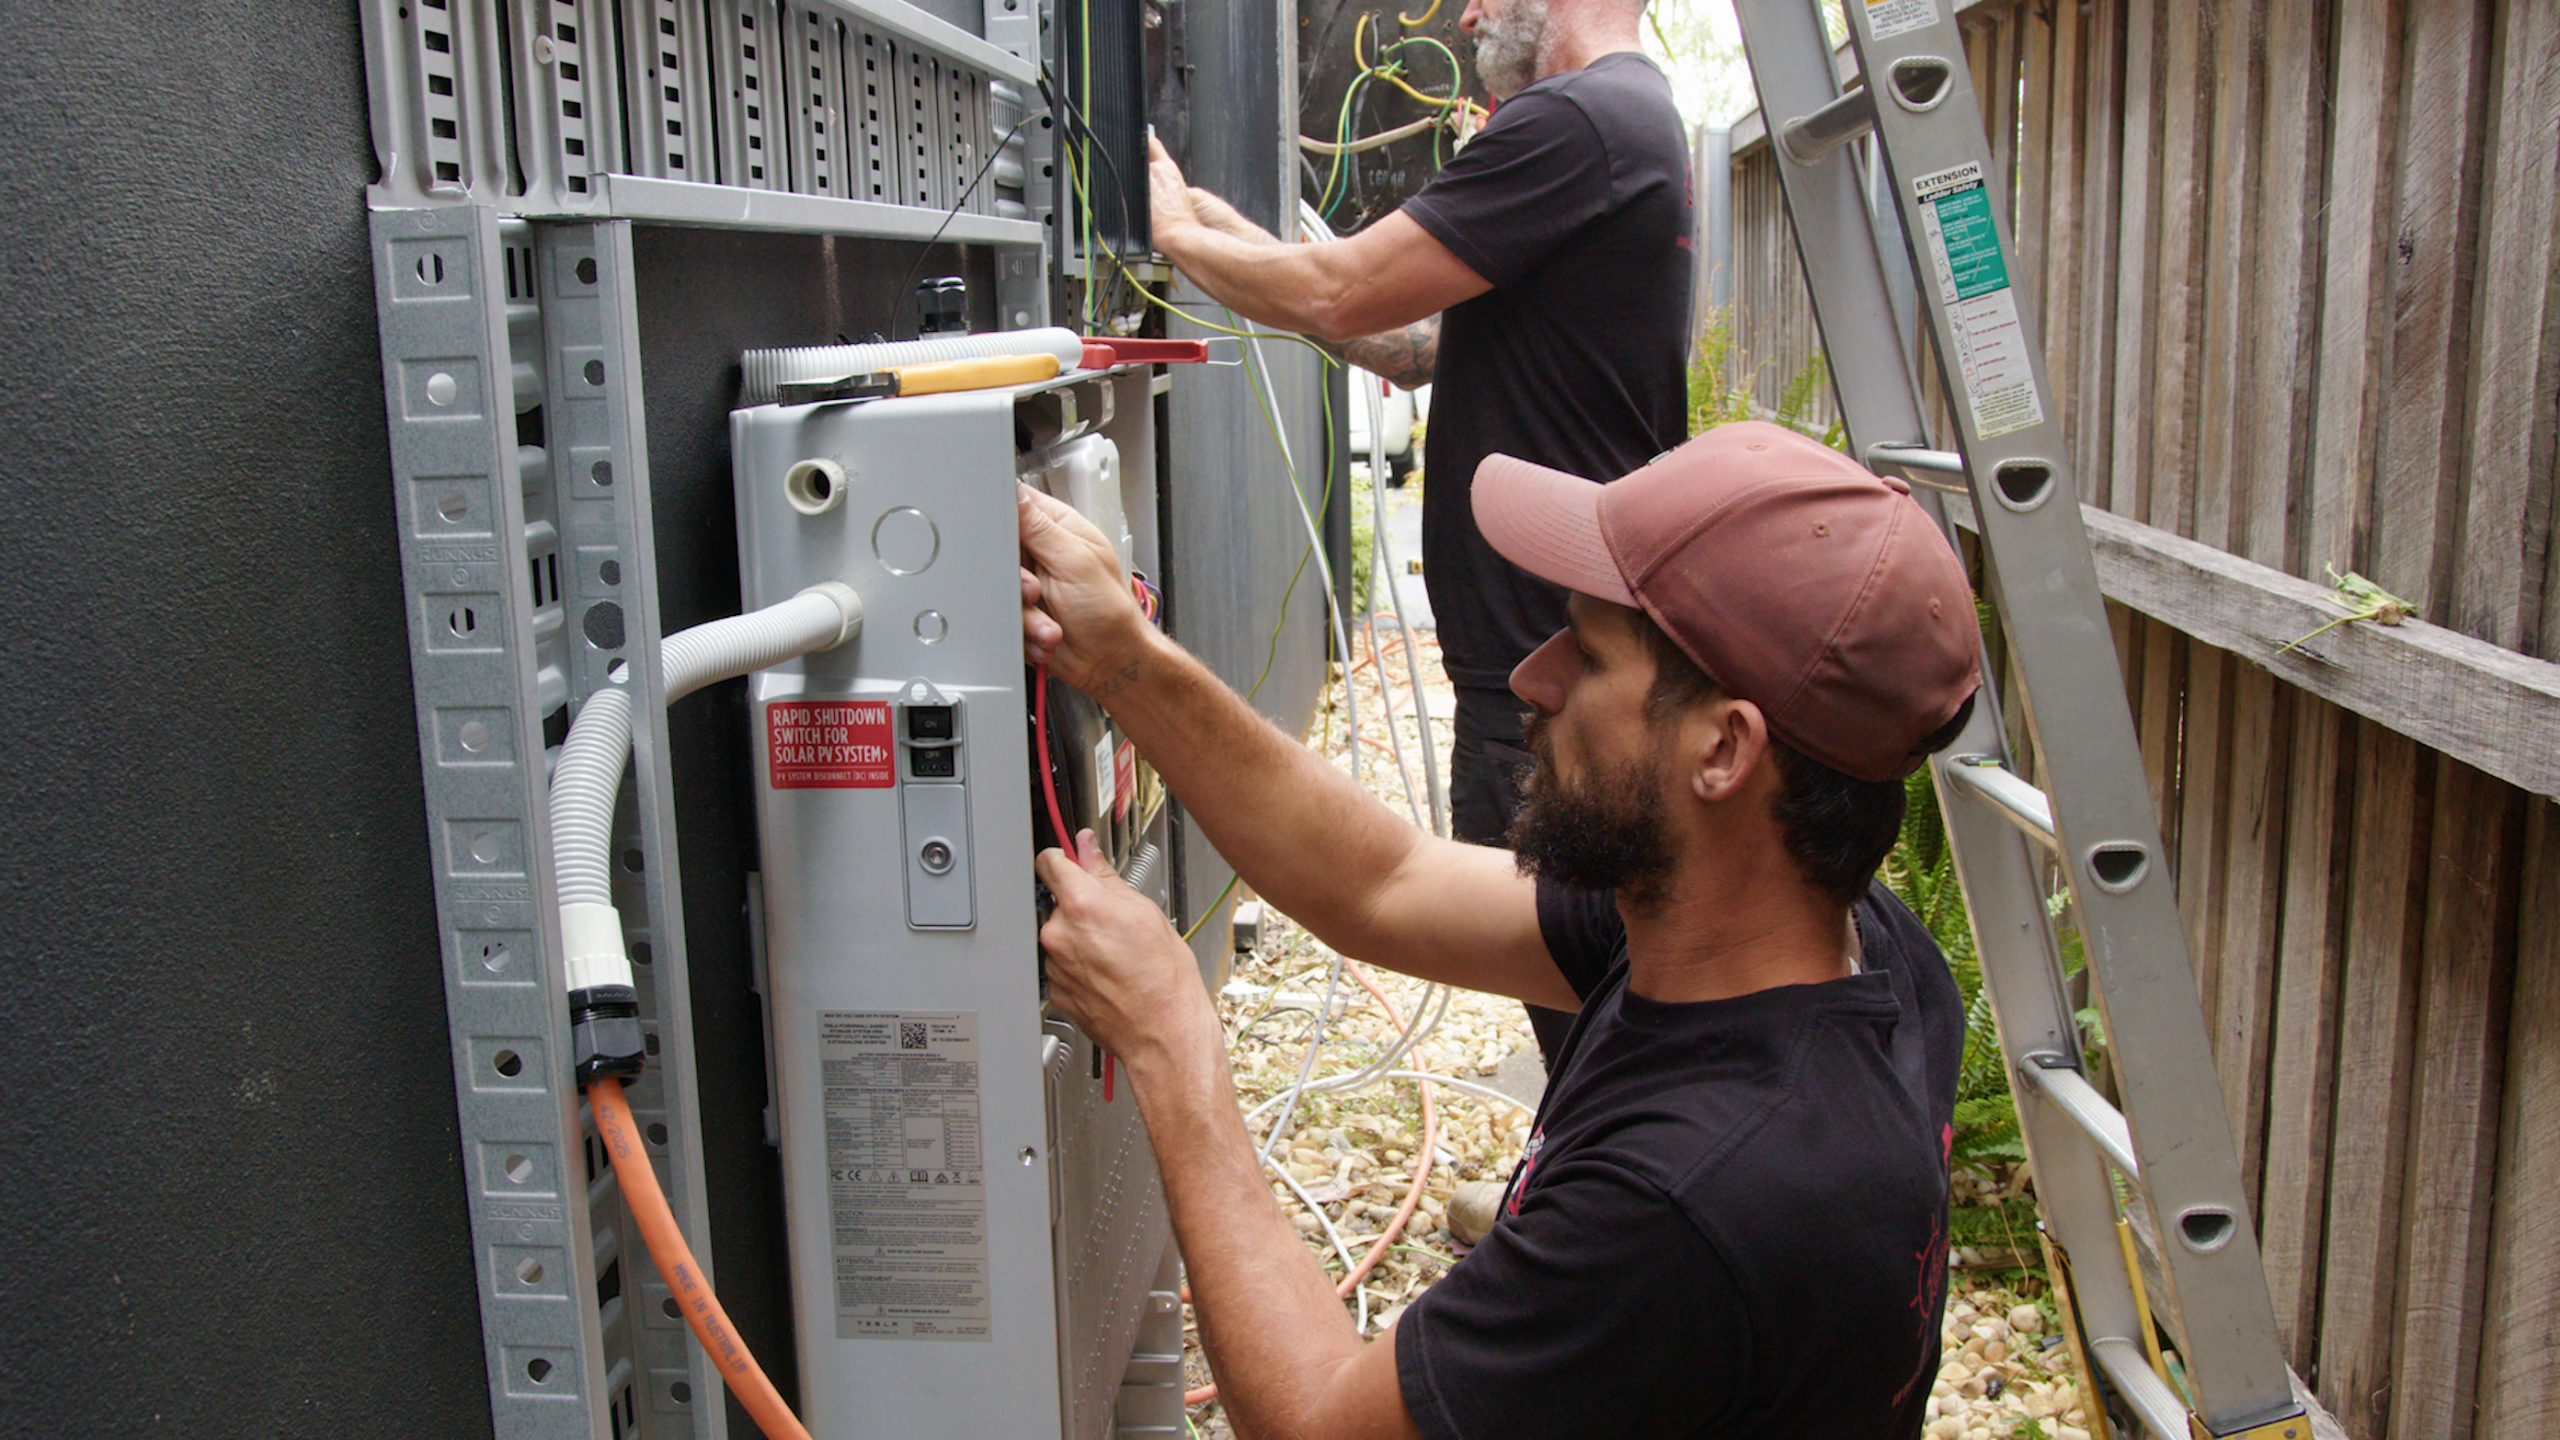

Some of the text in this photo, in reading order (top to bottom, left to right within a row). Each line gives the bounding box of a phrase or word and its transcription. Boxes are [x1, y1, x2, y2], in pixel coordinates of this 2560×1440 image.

[1916, 165, 1978, 190] EXTENSION
[1924, 189, 1952, 201] Ladder
[1952, 181, 1979, 196] Safety
[773, 708, 886, 726] RAPID SHUTDOWN
[774, 727, 848, 744] SWITCH FOR
[775, 746, 881, 763] SOLAR PV SYSTEM
[925, 750, 940, 759] OFF
[776, 771, 889, 780] PV SYSTEM DISCONNECT (DC) INSIDE
[601, 1105, 632, 1158] 42/2025
[848, 1170, 861, 1181] CE
[673, 1263, 748, 1374] MADE IN AUSTRALIA
